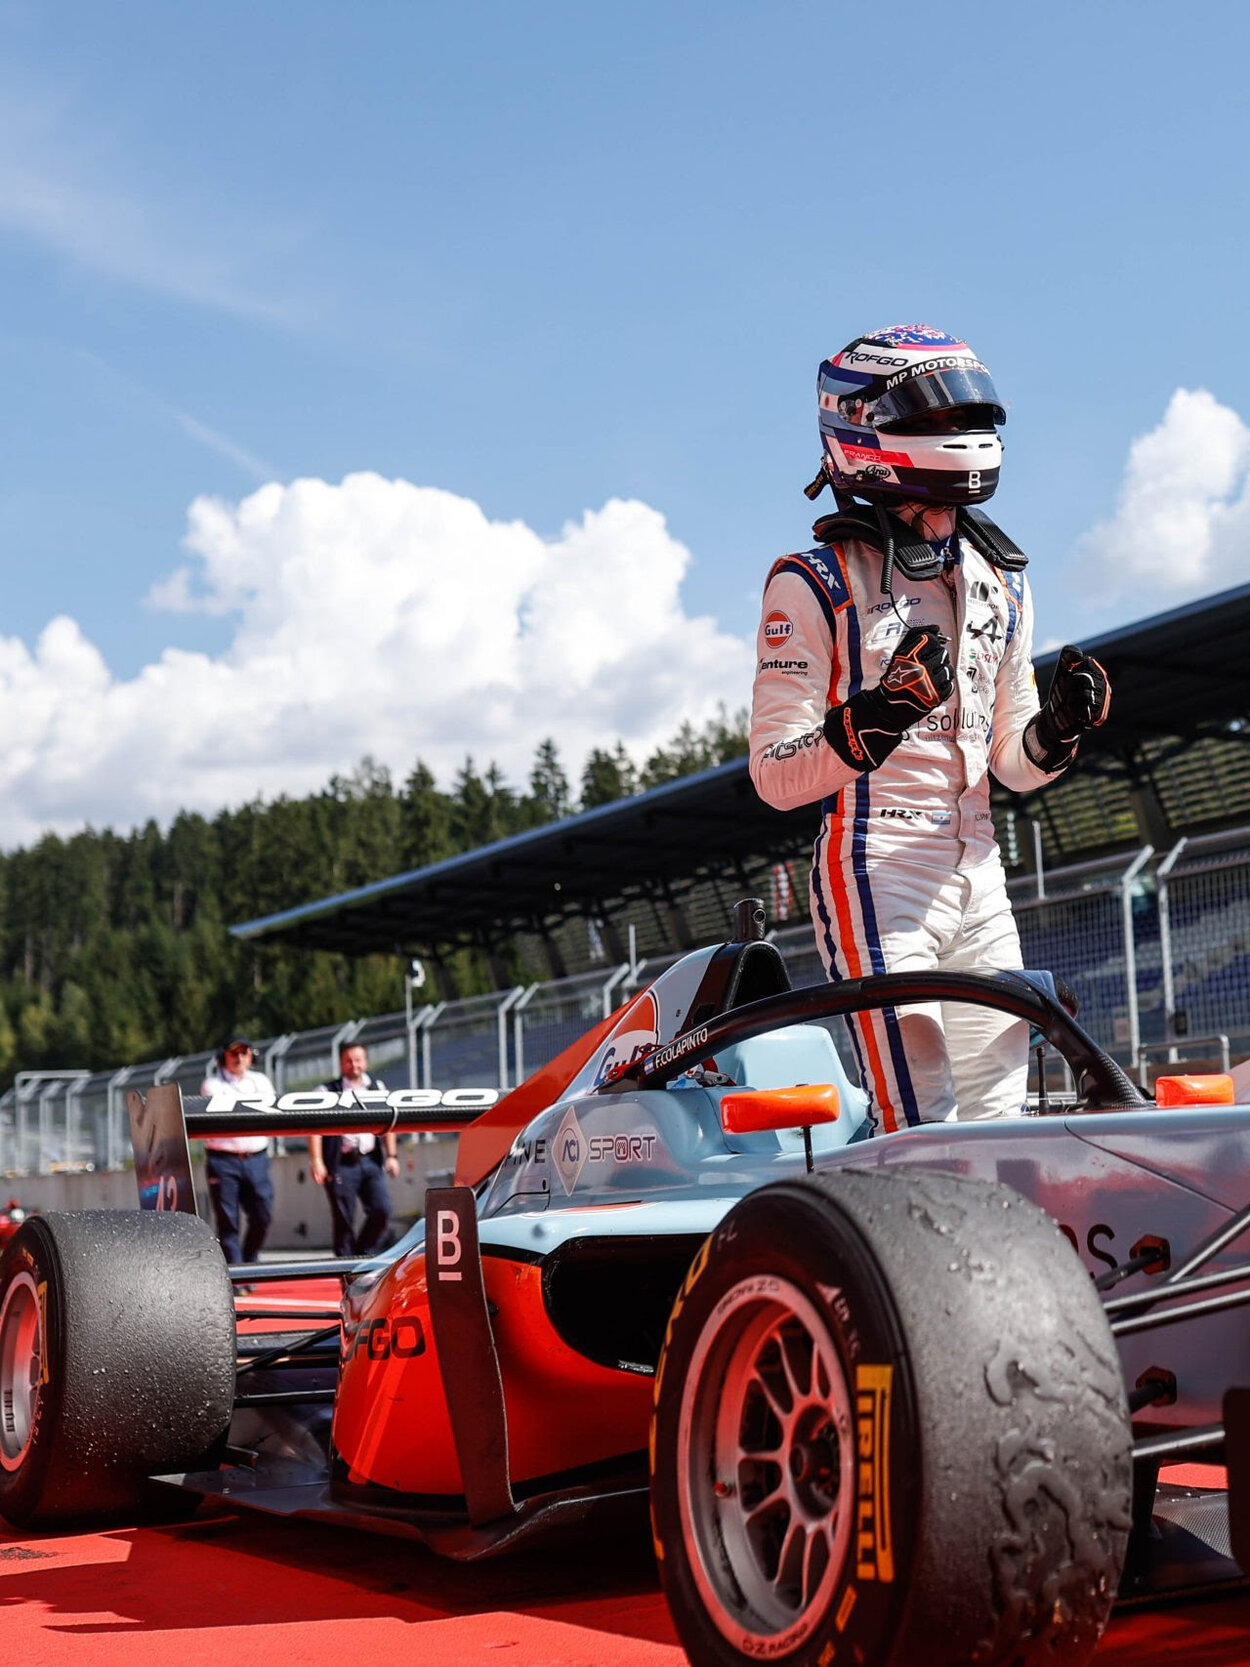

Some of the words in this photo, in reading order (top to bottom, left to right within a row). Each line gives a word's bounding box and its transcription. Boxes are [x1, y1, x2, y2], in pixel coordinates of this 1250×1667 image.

[844, 351, 909, 367] ROFGO
[886, 372, 908, 391] MP
[911, 357, 990, 378] MOTORSPO
[968, 471, 982, 489] B
[801, 552, 841, 590] HRX
[765, 624, 791, 636] Gulf
[880, 808, 922, 819] HRX
[205, 1088, 500, 1114] ROFGO
[590, 1135, 656, 1161] SPORT
[437, 1210, 462, 1265] B
[345, 1316, 427, 1362] FGO
[857, 1365, 895, 1584] PIRELLI
